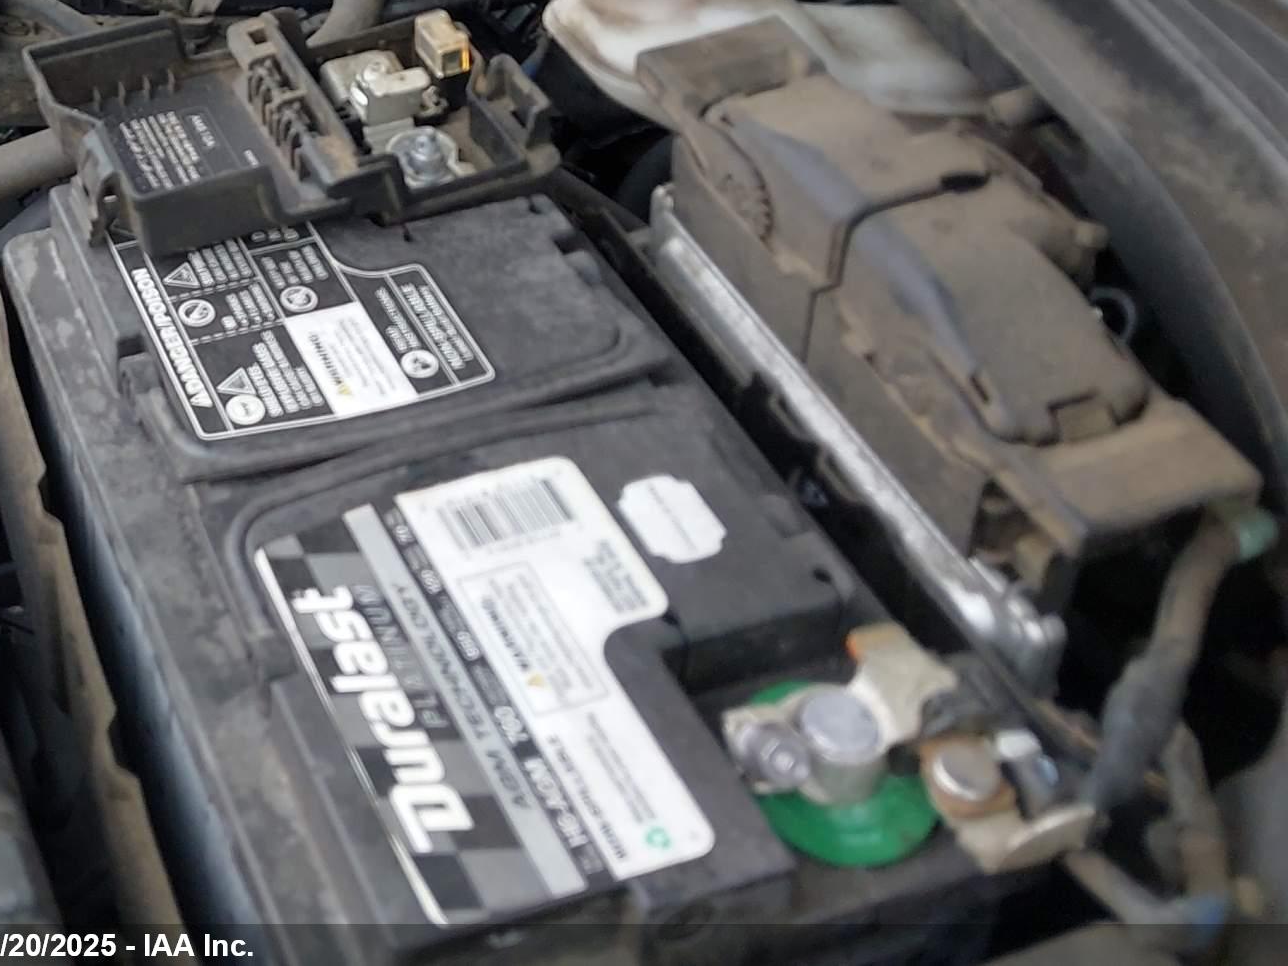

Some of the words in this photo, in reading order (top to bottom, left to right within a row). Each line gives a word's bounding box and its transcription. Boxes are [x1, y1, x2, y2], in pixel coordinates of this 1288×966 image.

[291, 585, 476, 854] Duralast
[349, 584, 450, 729] PLATINUM
[391, 584, 486, 740] TECHNOLOGY
[486, 750, 532, 810] AGM
